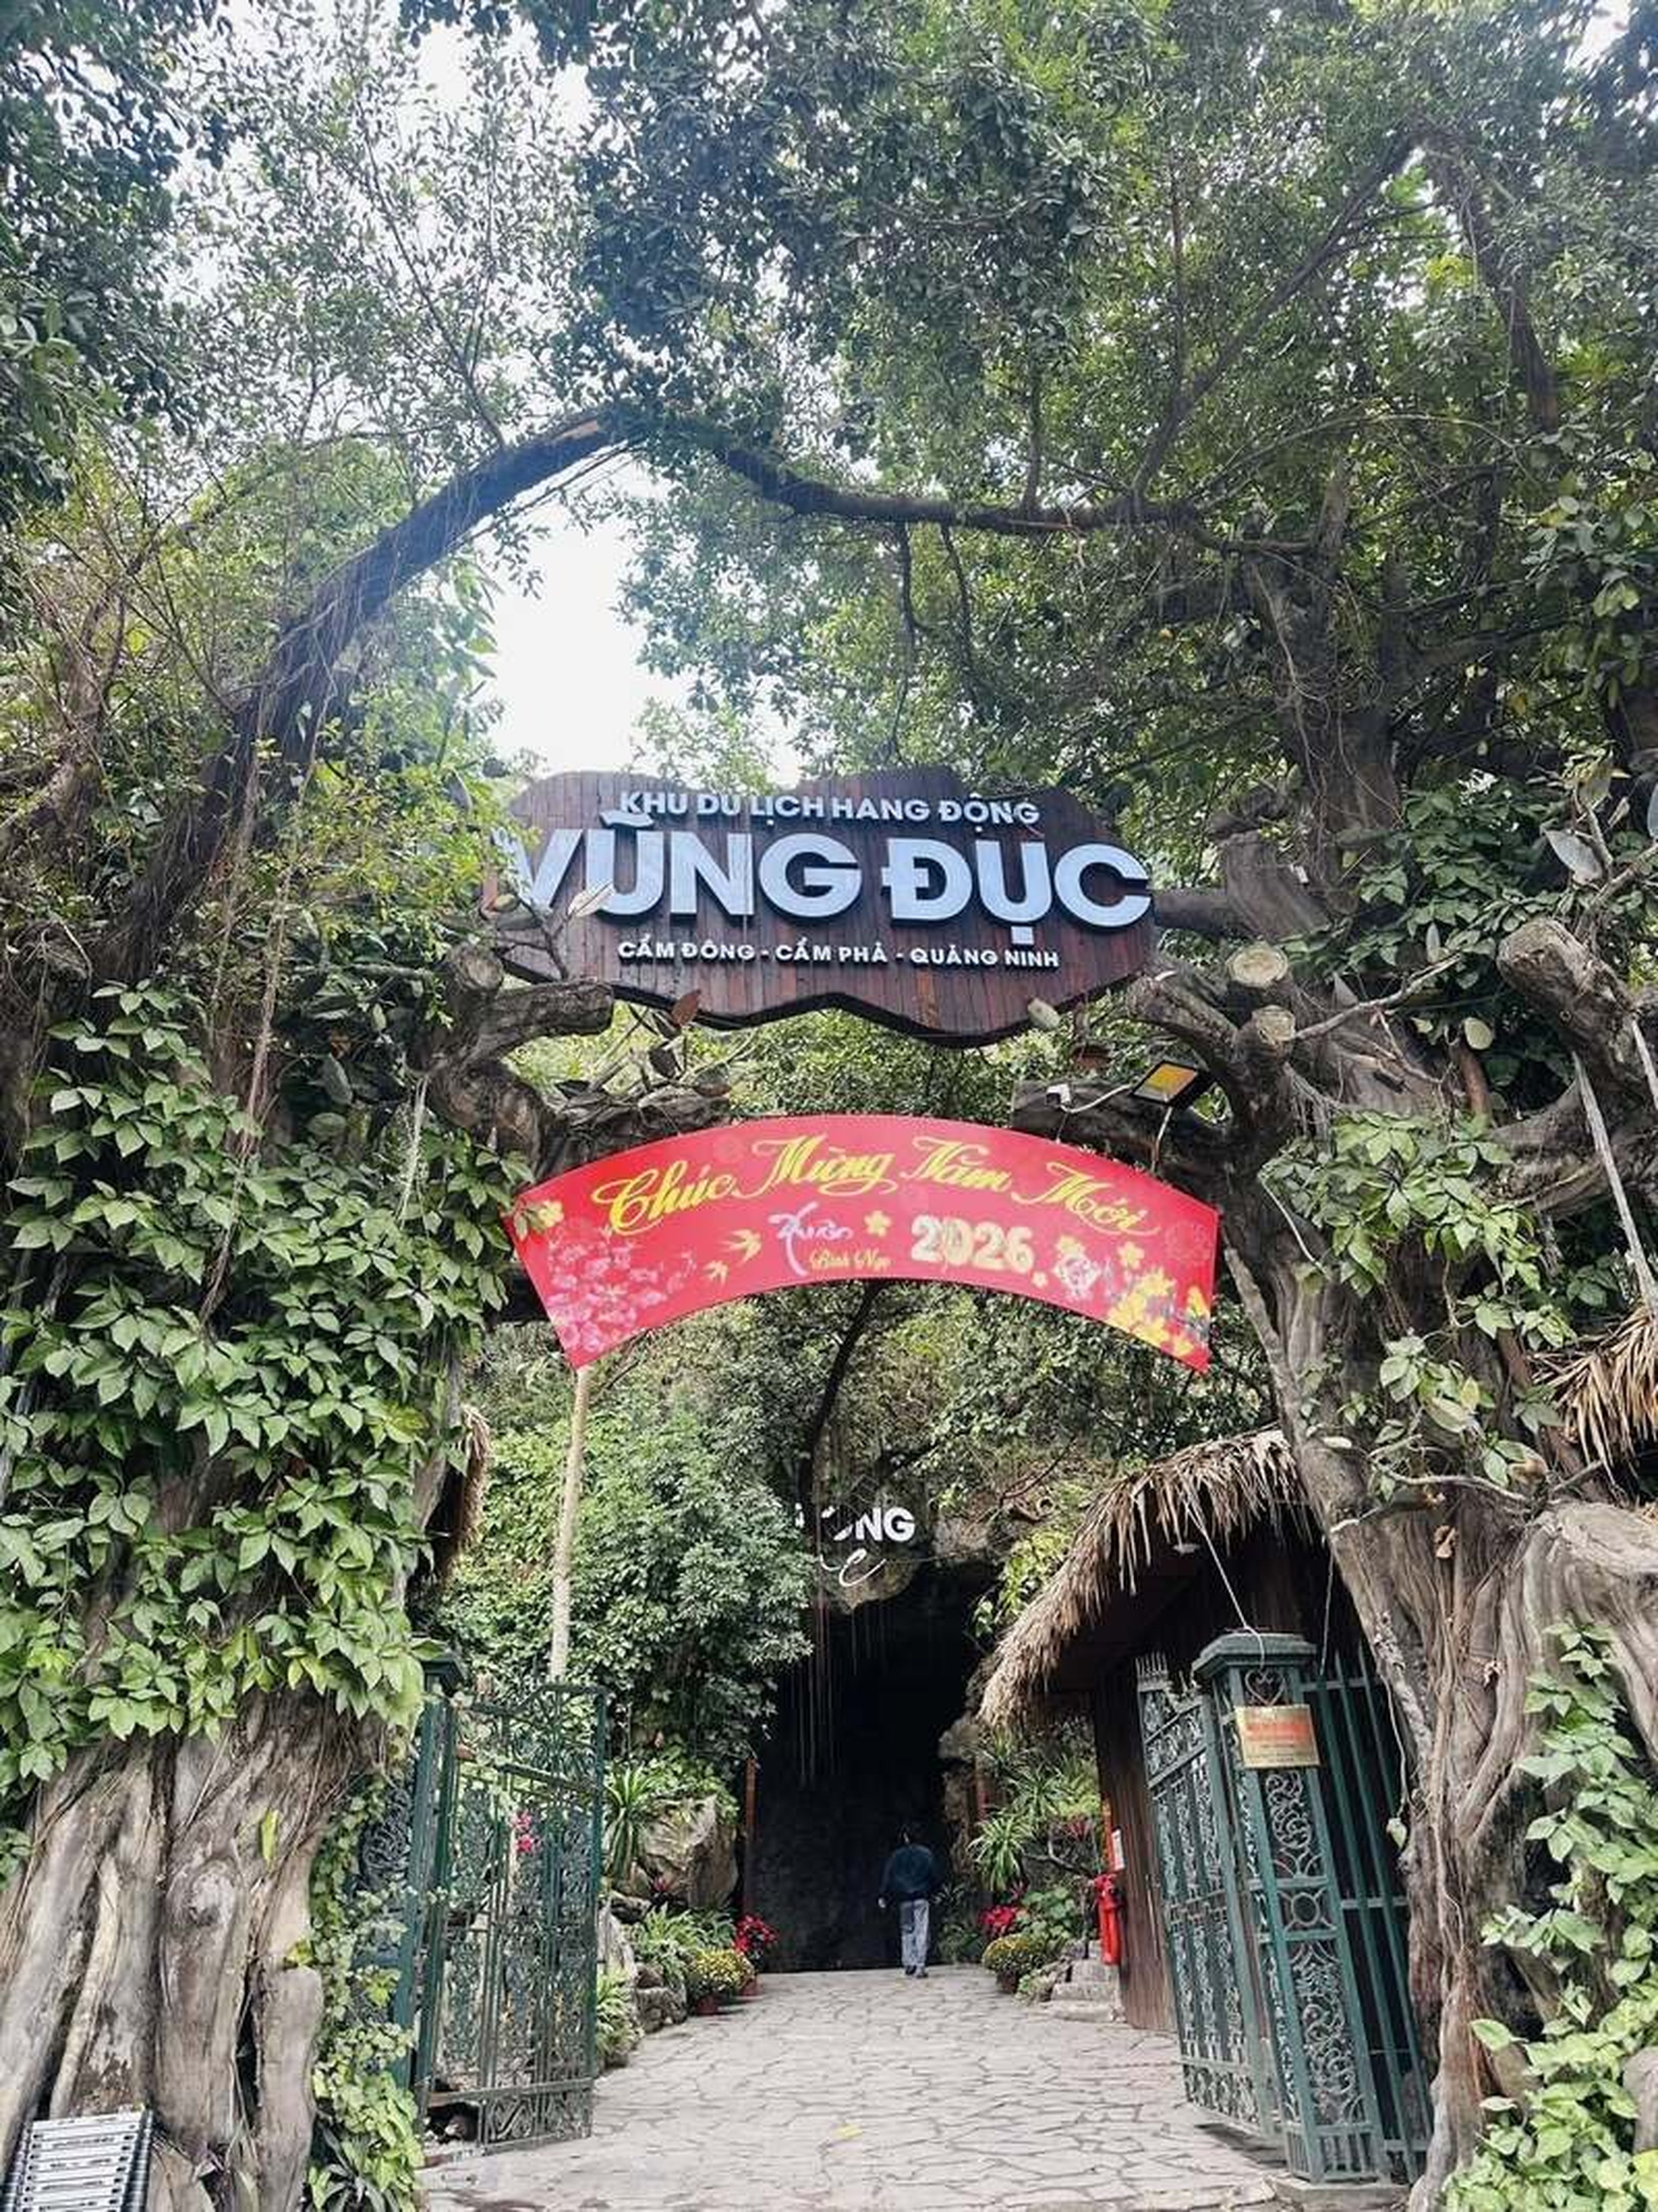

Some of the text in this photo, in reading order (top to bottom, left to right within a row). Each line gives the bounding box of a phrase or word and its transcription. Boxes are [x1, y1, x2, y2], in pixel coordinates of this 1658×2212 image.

[620, 791, 1039, 833] KHU DU LỊCH HANG ĐỘNG
[881, 837, 1152, 945] ĐỤC
[681, 938, 755, 960] ĐÔNG
[838, 941, 888, 962] PHẢ
[910, 944, 998, 965] QUẢNG
[1004, 949, 1060, 967] NINH
[591, 1160, 737, 1236] Chúc
[732, 1133, 899, 1197] Mừng
[911, 1214, 1035, 1274] 2026
